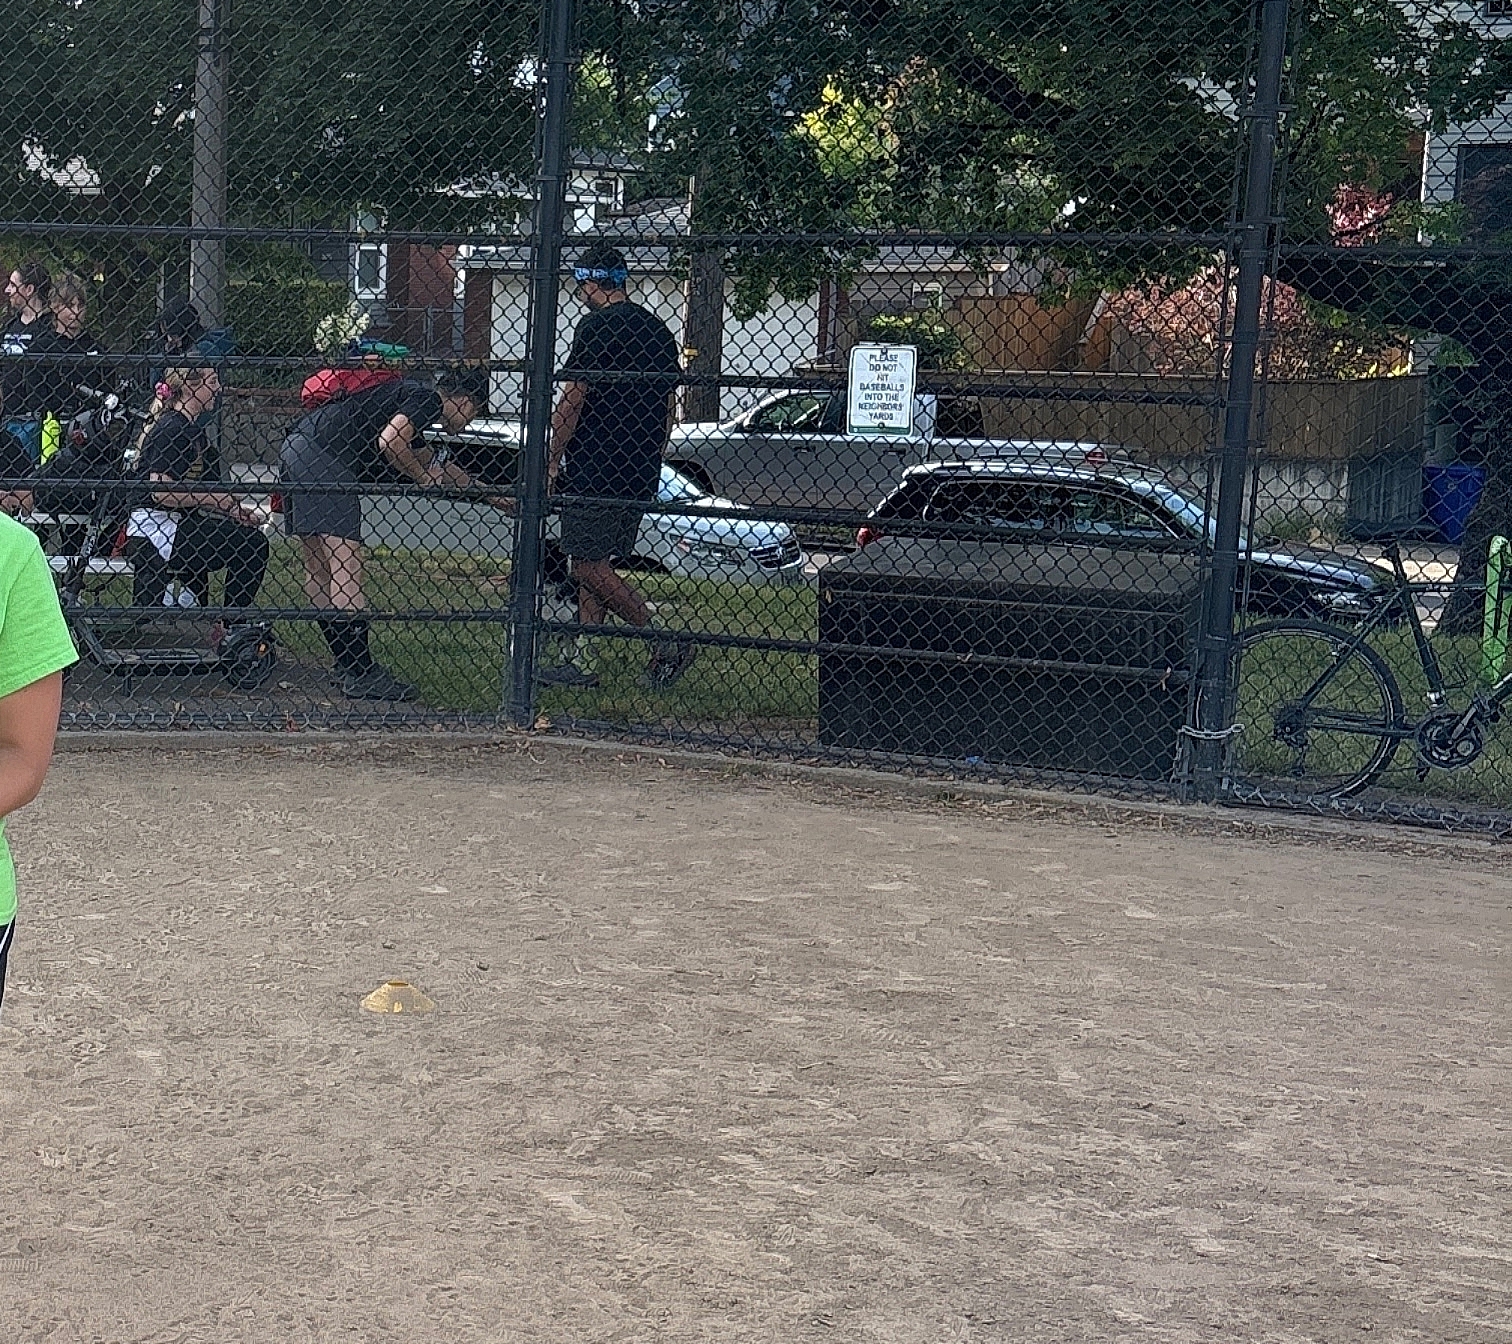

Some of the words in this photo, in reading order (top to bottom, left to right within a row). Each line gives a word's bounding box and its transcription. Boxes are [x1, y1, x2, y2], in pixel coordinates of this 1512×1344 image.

[869, 354, 898, 362] PLEASE
[869, 364, 881, 372] DO
[882, 364, 898, 372] NOT
[859, 383, 904, 392] BASEBALLS
[864, 393, 884, 401] INTO
[885, 393, 900, 402] THE
[868, 412, 894, 421] YARDS
